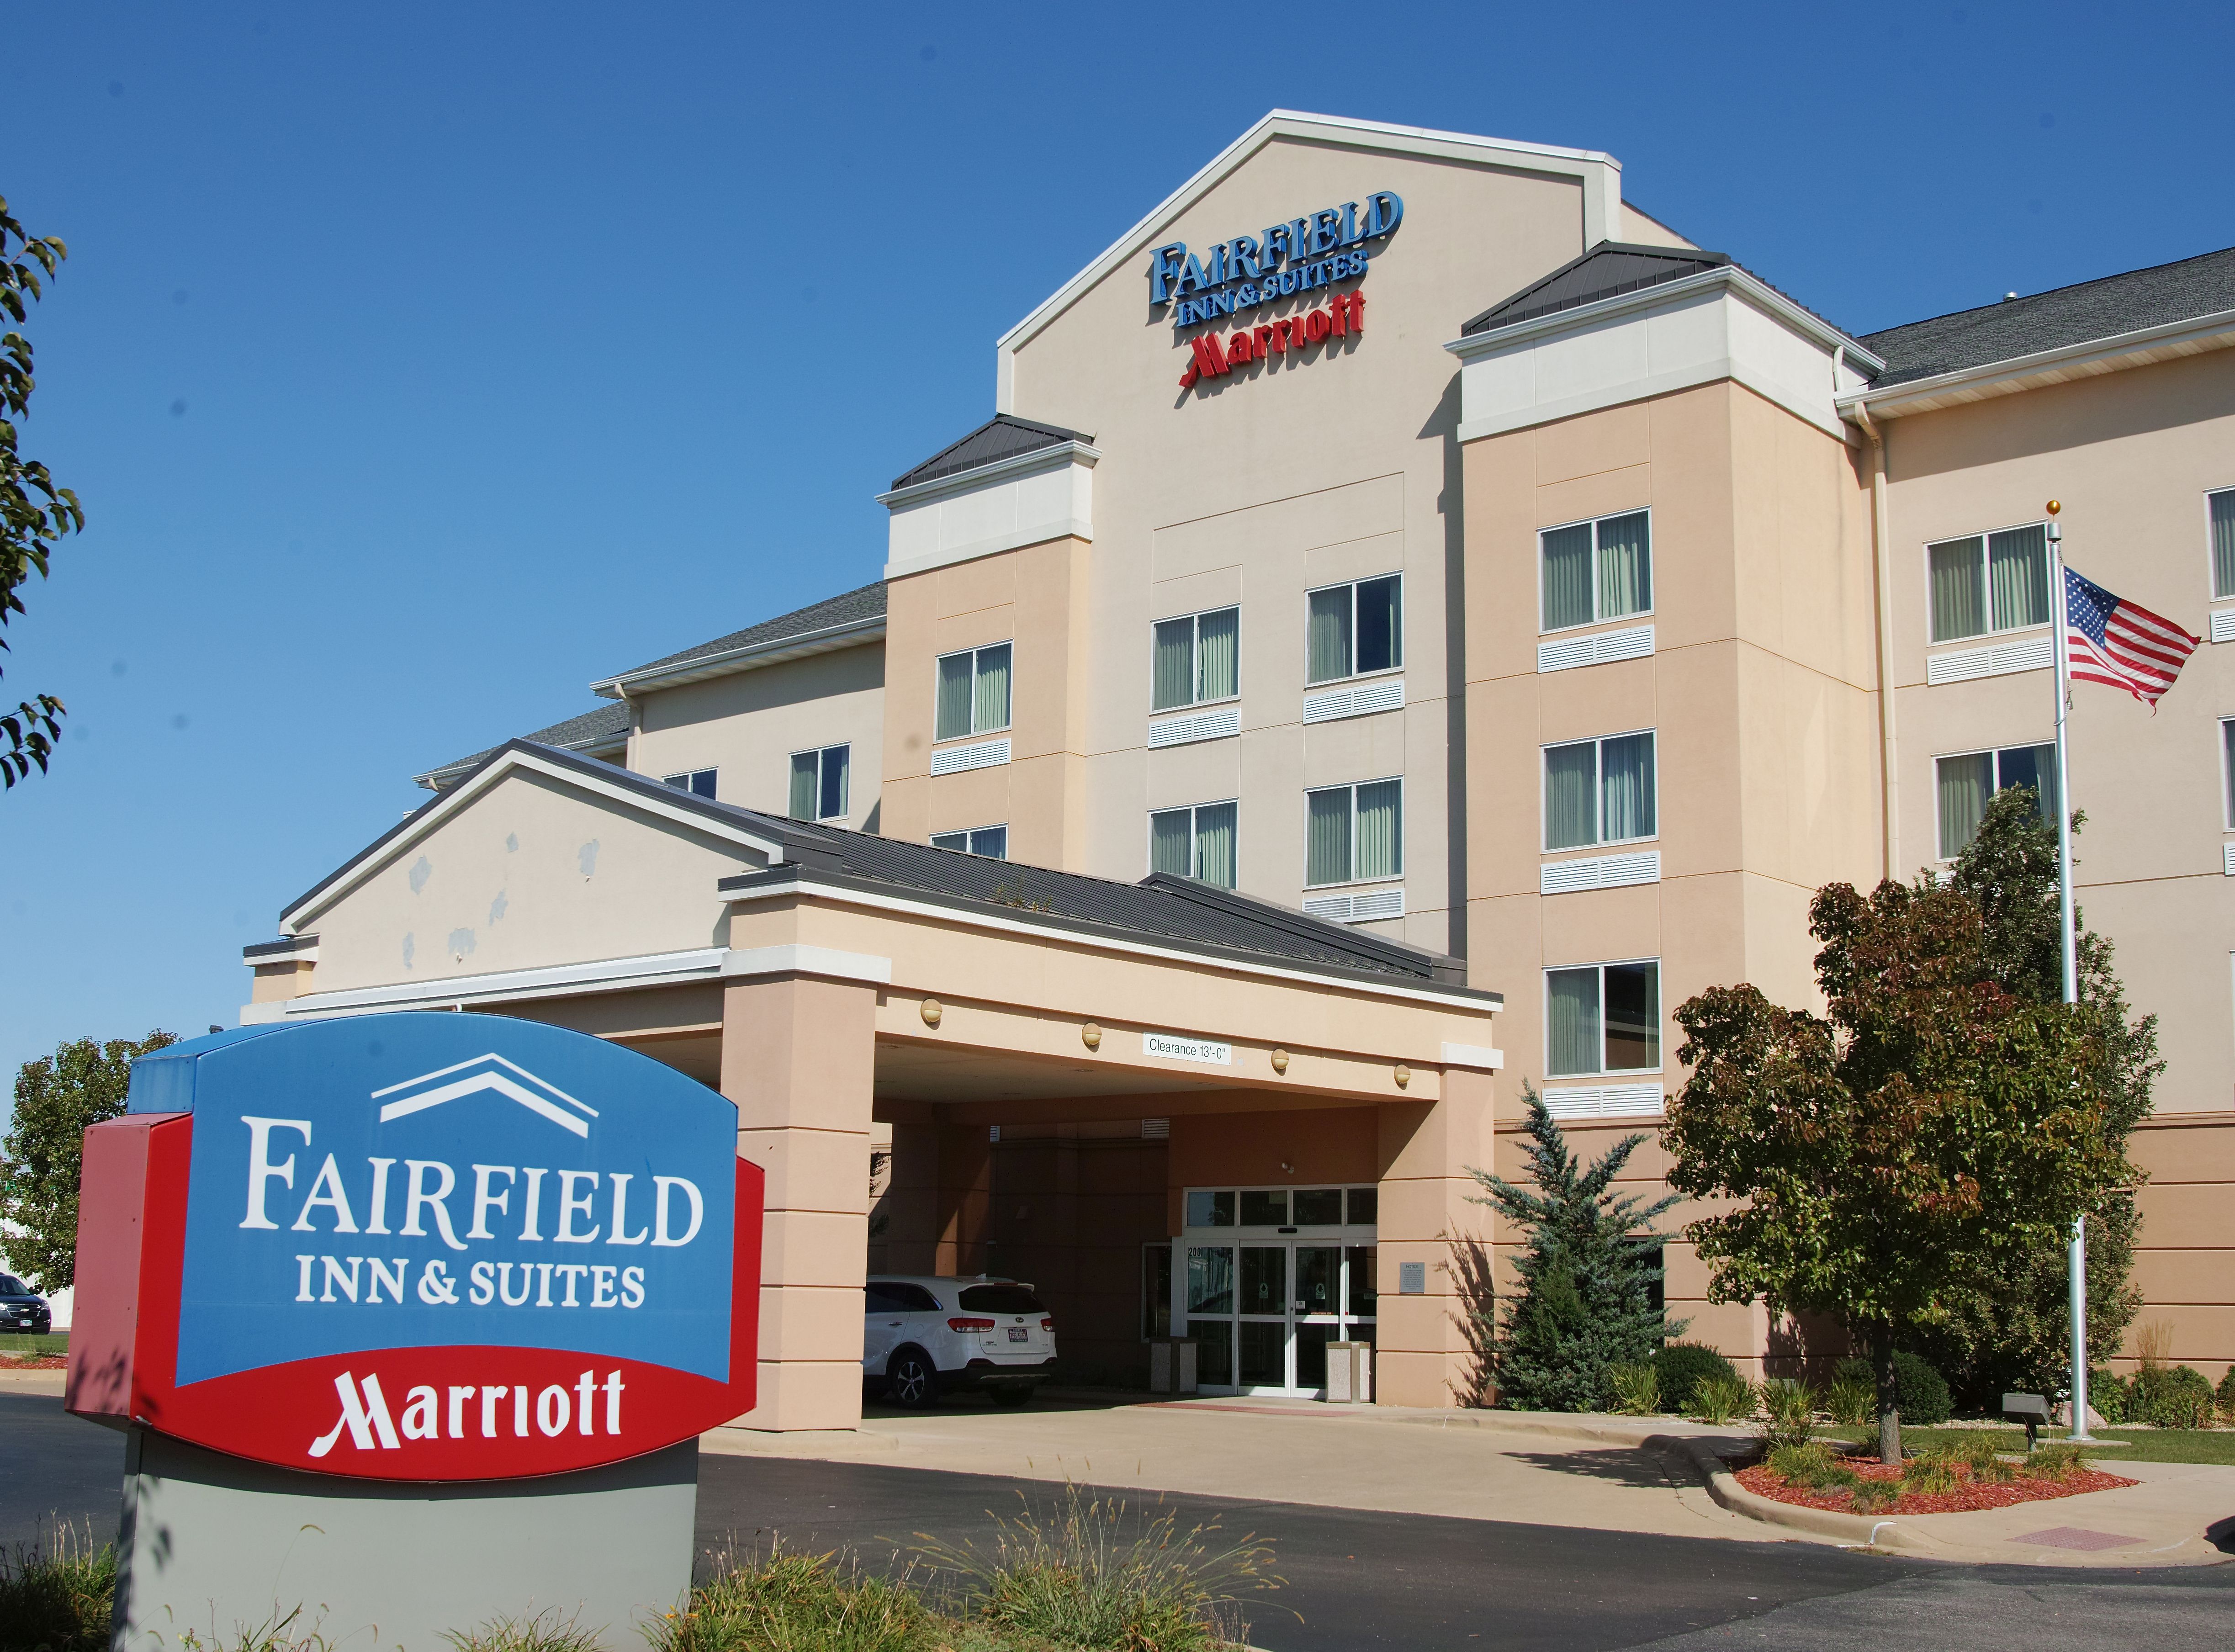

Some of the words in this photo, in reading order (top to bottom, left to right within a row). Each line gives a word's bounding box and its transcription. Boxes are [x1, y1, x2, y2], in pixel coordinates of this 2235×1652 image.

[1149, 191, 1404, 305] FAIRFIELD
[1176, 288, 1237, 328] INN
[1236, 282, 1262, 309] &
[1262, 249, 1369, 301] SUITES
[1179, 289, 1366, 388] Marriott
[1149, 1038, 1196, 1056] Clearance
[239, 1116, 704, 1250] FAIRFIELD
[296, 1255, 409, 1304] INN
[418, 1260, 459, 1305] &
[469, 1262, 645, 1309] SUITES
[1189, 1247, 1201, 1257] 200
[308, 1370, 625, 1457] Marriott
